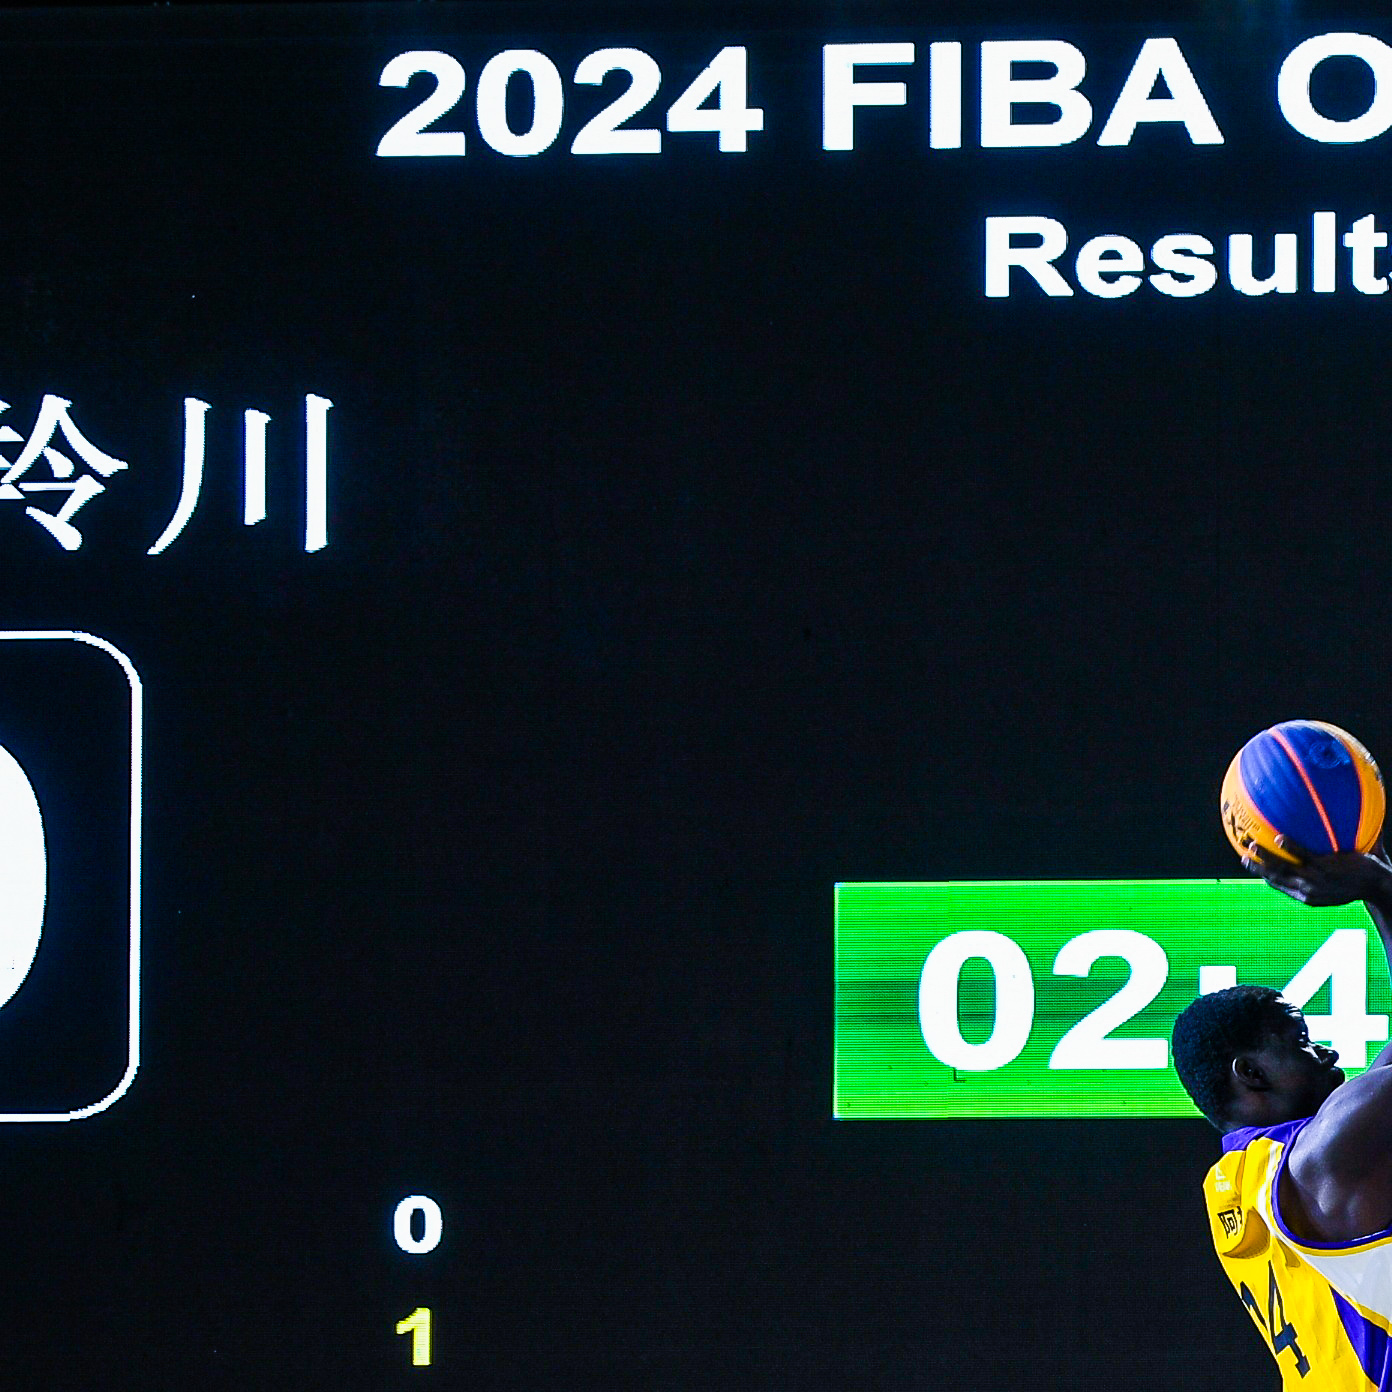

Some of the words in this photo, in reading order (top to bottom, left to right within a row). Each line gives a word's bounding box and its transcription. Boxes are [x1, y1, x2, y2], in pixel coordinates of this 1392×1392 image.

[375, 46, 764, 158] 2024
[822, 38, 1225, 151] FIBA
[393, 1195, 443, 1254] 0
[396, 1307, 432, 1366] 1
